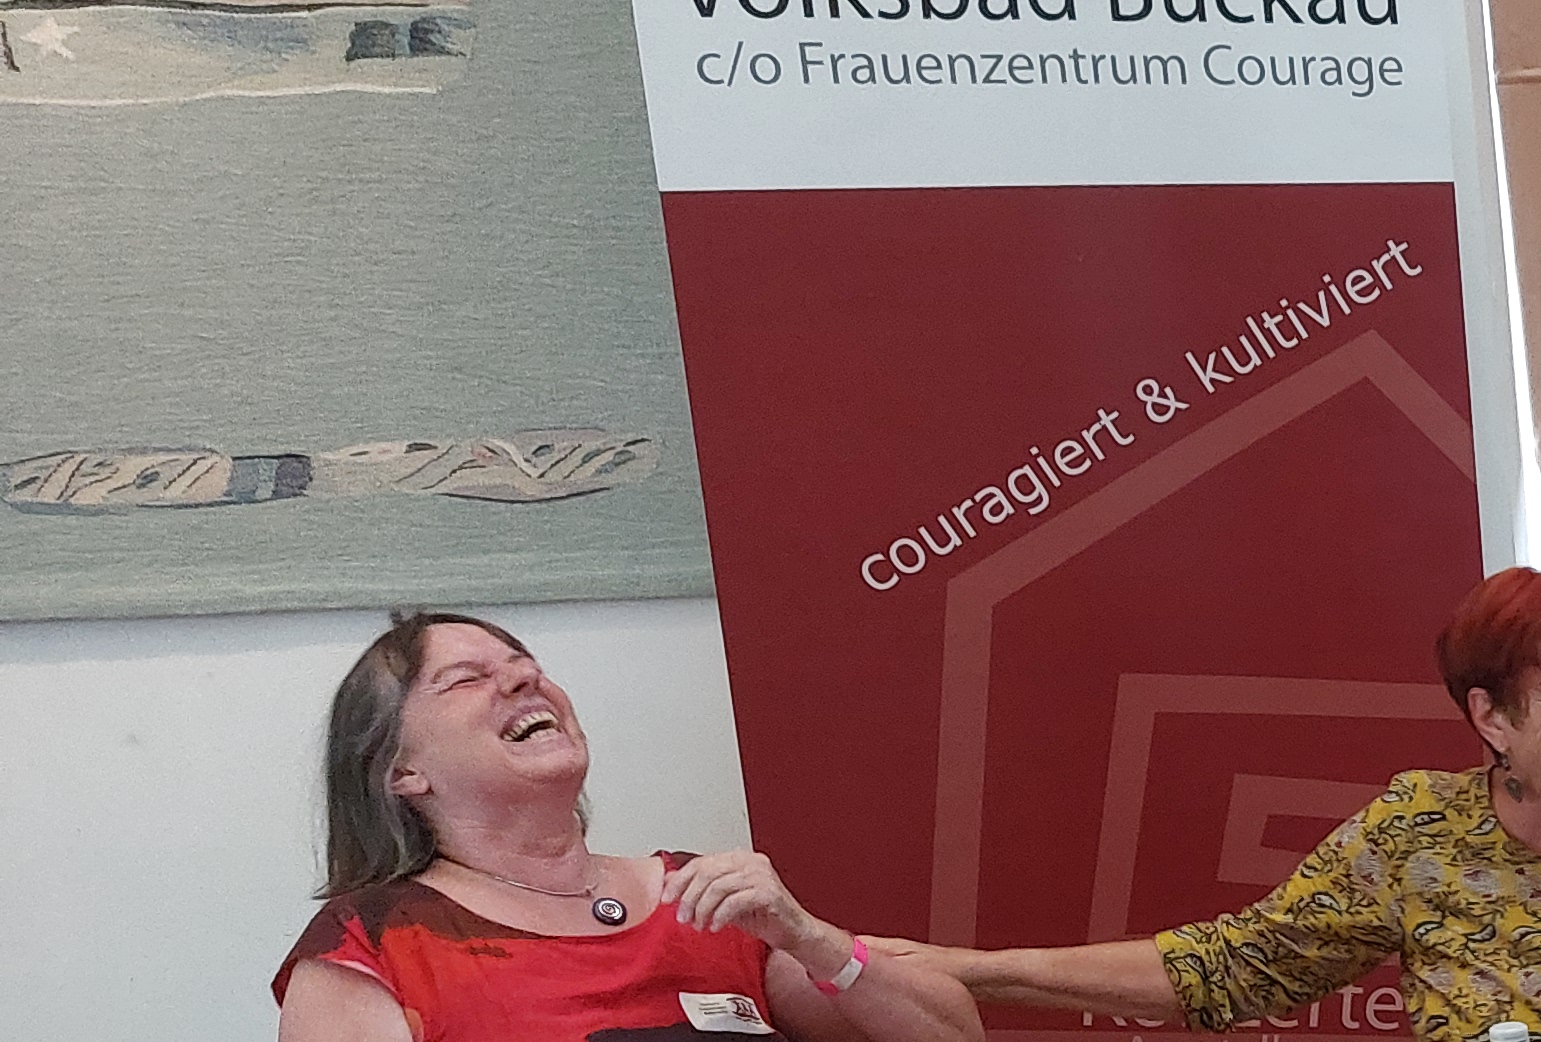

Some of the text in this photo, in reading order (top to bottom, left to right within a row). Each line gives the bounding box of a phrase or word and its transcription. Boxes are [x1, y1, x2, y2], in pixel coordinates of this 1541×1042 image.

[697, 41, 1404, 98] c/o Frauenzentrum Courage
[860, 238, 1423, 592] couragiert & kultiviert
